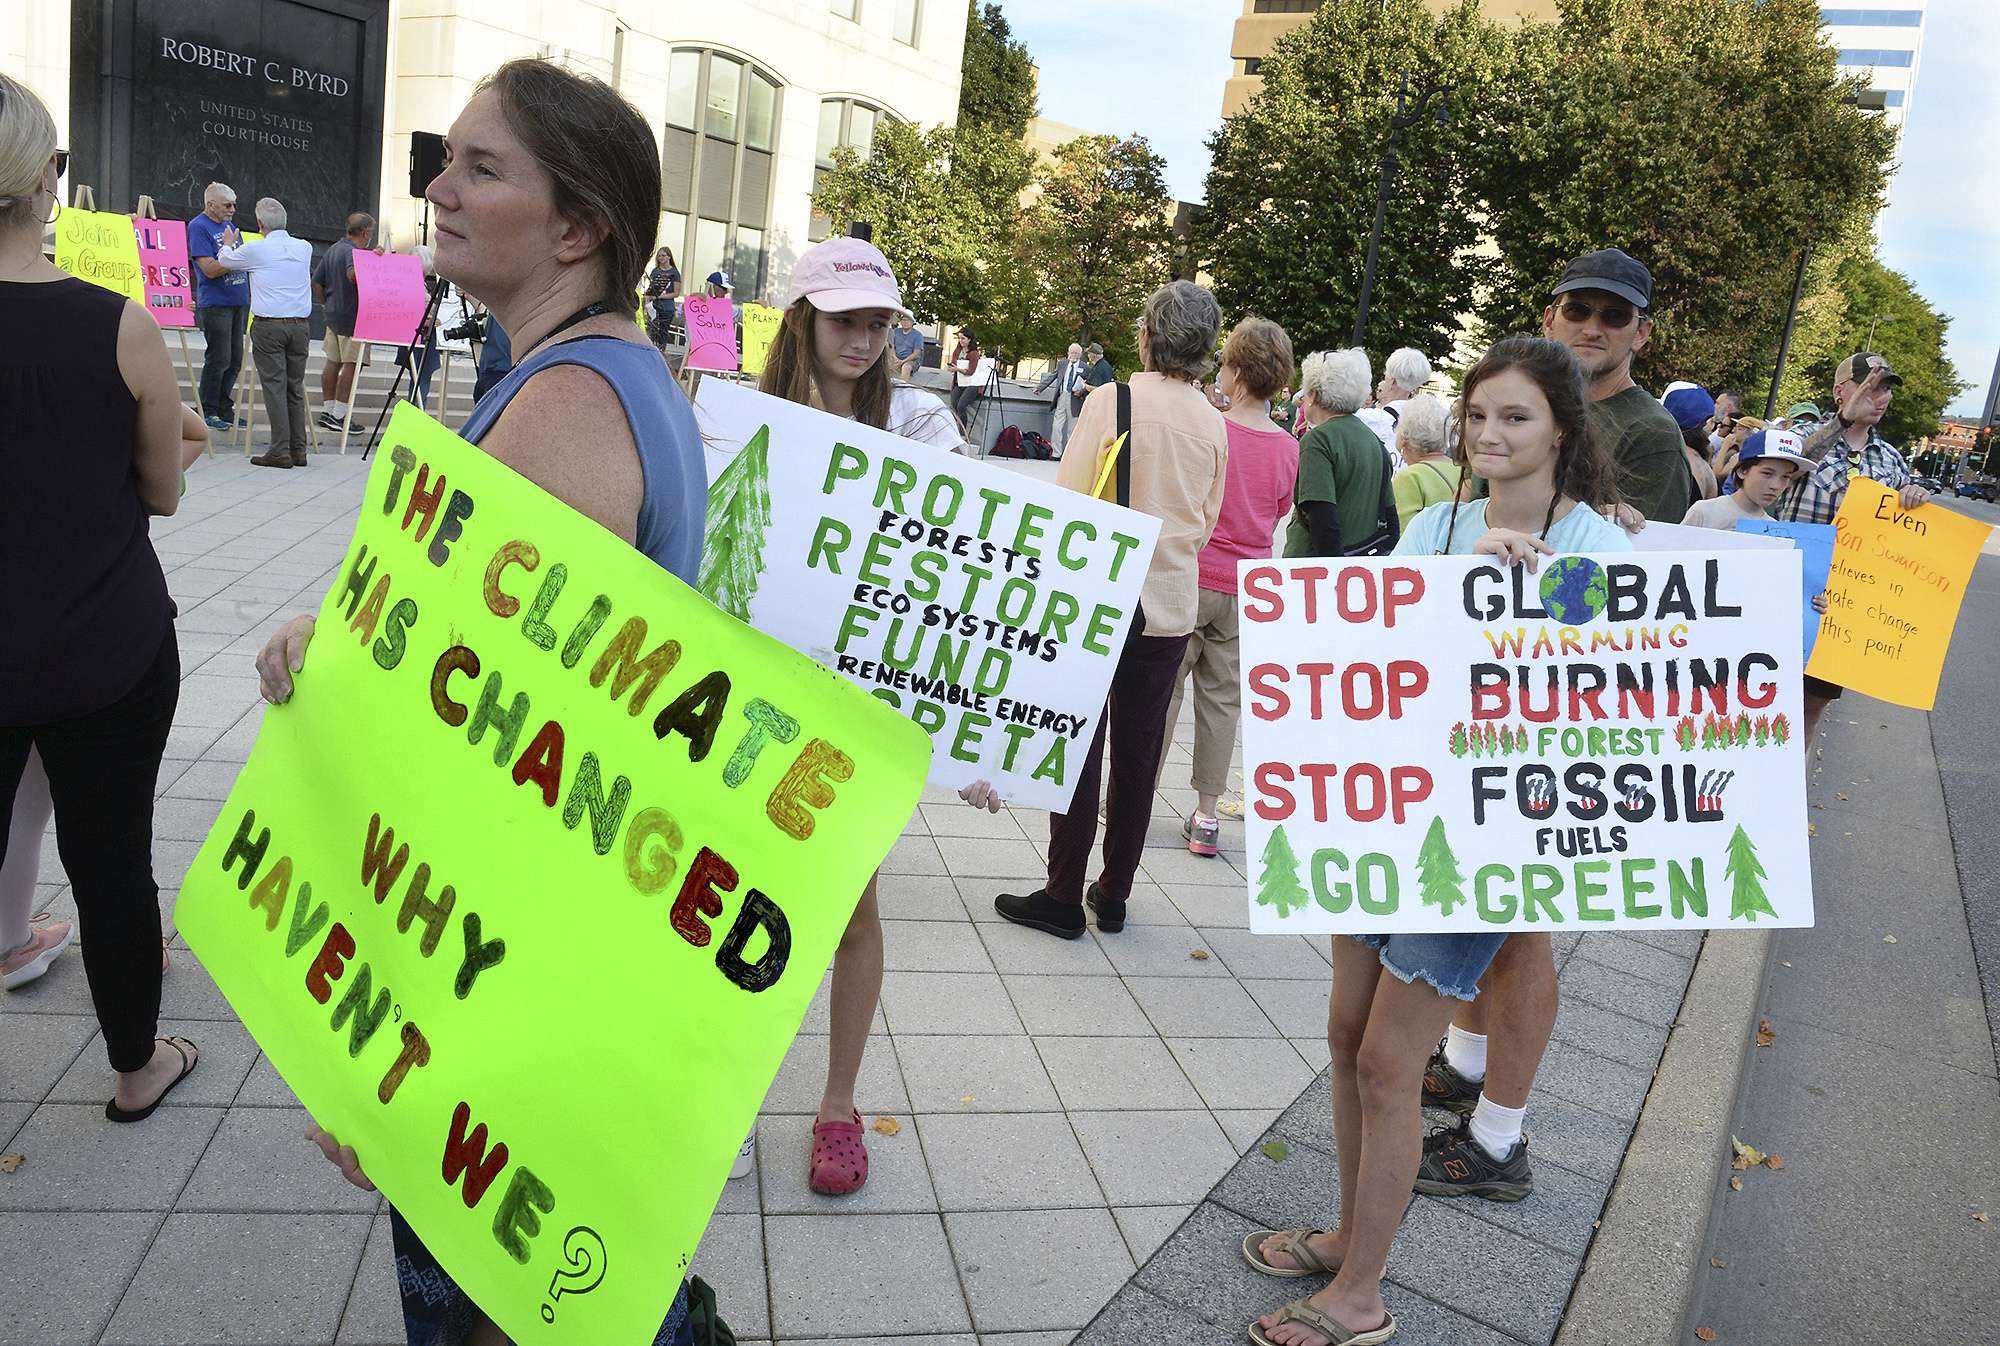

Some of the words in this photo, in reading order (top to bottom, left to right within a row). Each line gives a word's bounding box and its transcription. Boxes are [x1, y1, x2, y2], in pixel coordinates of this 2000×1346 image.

[161, 36, 257, 77] ROBERT
[264, 62, 284, 84] C.
[291, 67, 349, 97] BYRD
[201, 100, 256, 121] UNITED
[263, 113, 313, 133] STATES
[203, 121, 310, 152] COURTHOUSE
[66, 216, 119, 249] Join
[60, 256, 73, 273] a
[78, 248, 136, 293] Group
[689, 299, 710, 314] Go
[696, 314, 727, 329] Solar
[822, 442, 1140, 583] PROTECT
[879, 510, 1041, 580] FORESTS
[1875, 494, 1927, 537] Even
[806, 516, 1123, 657] RESTORE
[1830, 559, 1876, 585] elieves
[1889, 582, 1904, 598] in
[1835, 517, 1863, 552] Ron
[1871, 534, 1950, 593] Swanson
[854, 585, 911, 614] ECO
[922, 604, 1060, 663] SYSTEMS
[1243, 566, 1426, 628] STOP
[1462, 558, 1742, 626] GLOBAL
[1866, 604, 1919, 640] change
[382, 444, 475, 567] THE
[482, 538, 857, 842] CLIMATE
[834, 604, 1013, 698] FUND
[1484, 623, 1690, 660] WARMING
[1822, 616, 1853, 644] this
[836, 655, 987, 713] RENEWABLE
[995, 698, 1088, 740] ENERGY
[1247, 659, 1430, 721] STOP
[1470, 652, 1779, 723] BURNING
[336, 543, 418, 671] HAS
[430, 644, 793, 994] CHANGED
[871, 687, 1068, 787] RETA
[1537, 727, 1665, 757] FOREST
[1253, 761, 1434, 825] STOP
[1472, 763, 1736, 825] FOSSIL
[1536, 826, 1629, 858] FUELS
[360, 812, 507, 1001] WHY
[1310, 847, 1400, 915] GO
[1474, 856, 1707, 925] GREEN
[221, 808, 432, 1105] HAVEN'T
